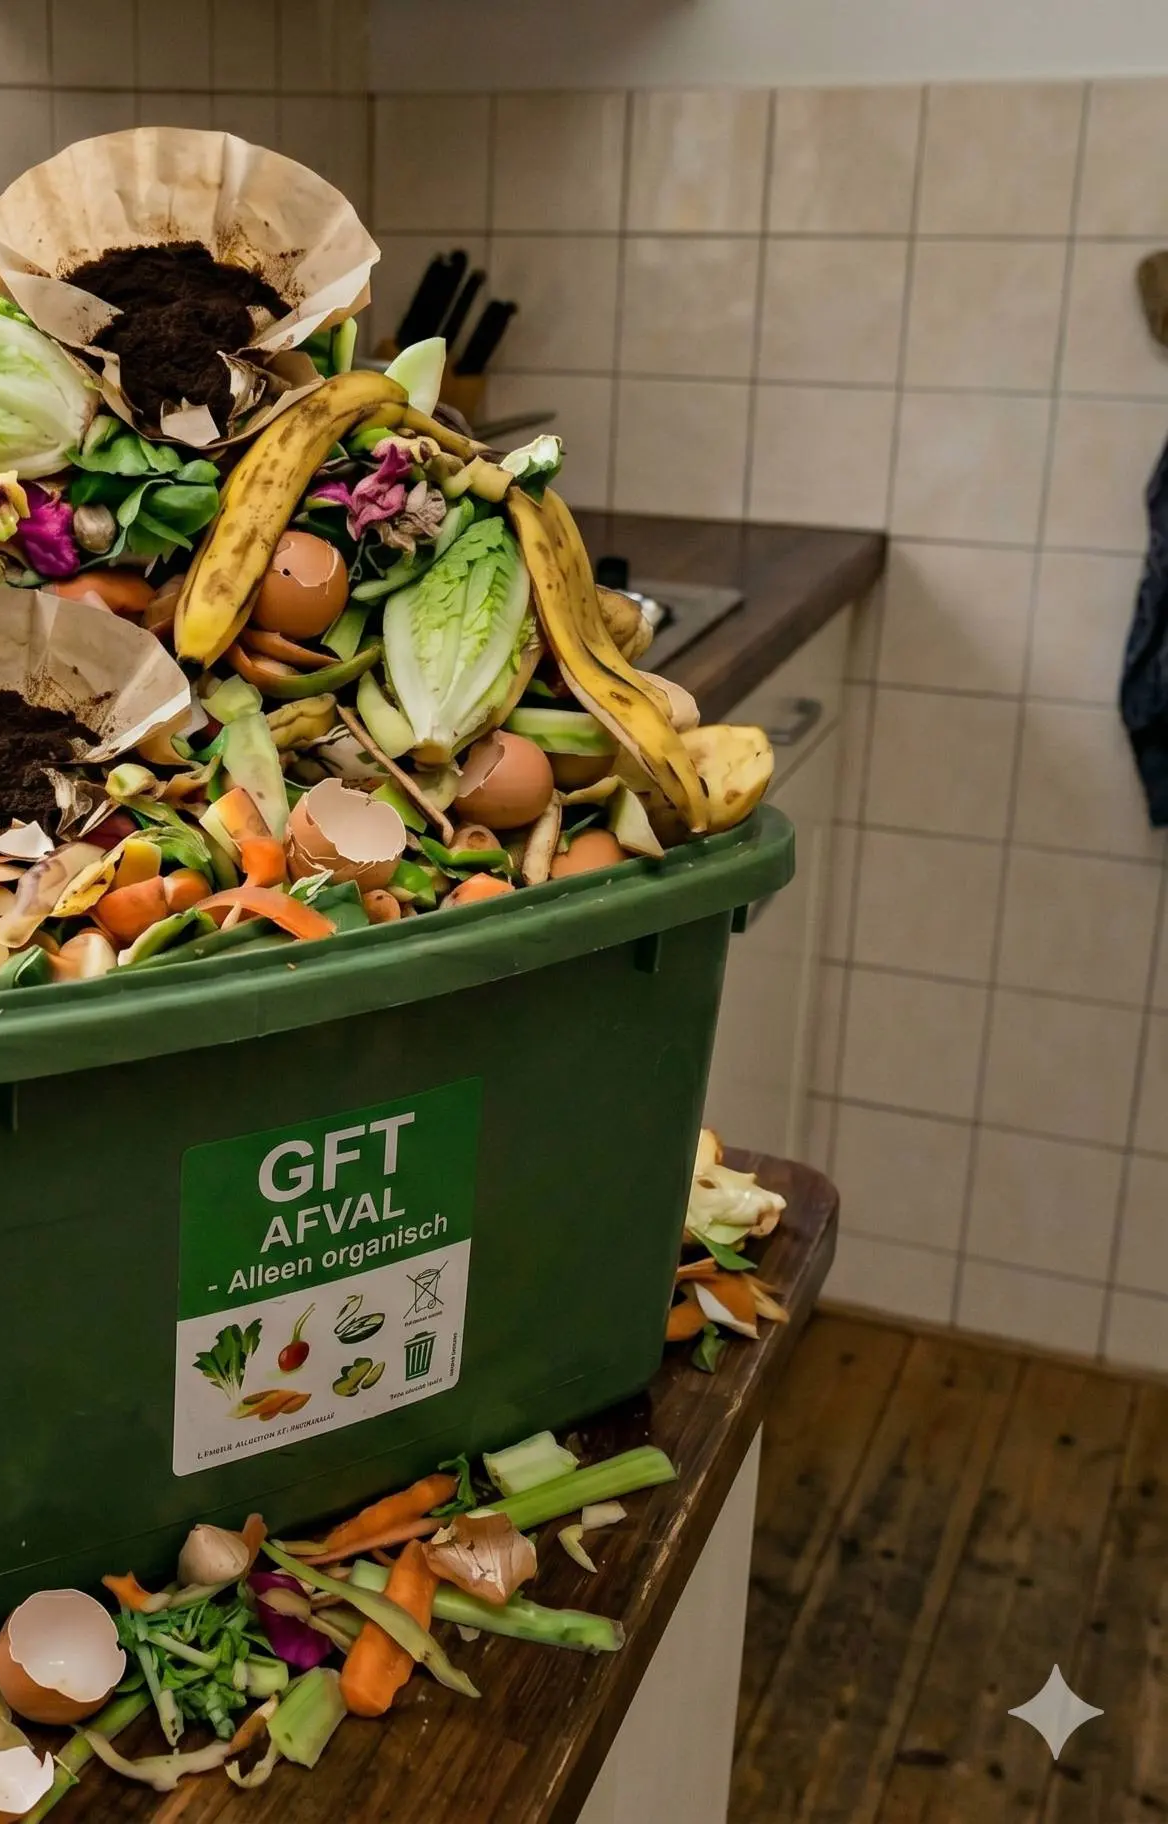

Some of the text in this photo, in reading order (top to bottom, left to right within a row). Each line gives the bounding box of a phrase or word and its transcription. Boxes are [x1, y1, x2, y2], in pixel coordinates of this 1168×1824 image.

[258, 1111, 416, 1203] GFT
[227, 1256, 313, 1294] Alleen
[321, 1212, 449, 1268] organisch
[259, 1187, 406, 1254] AFVAL
